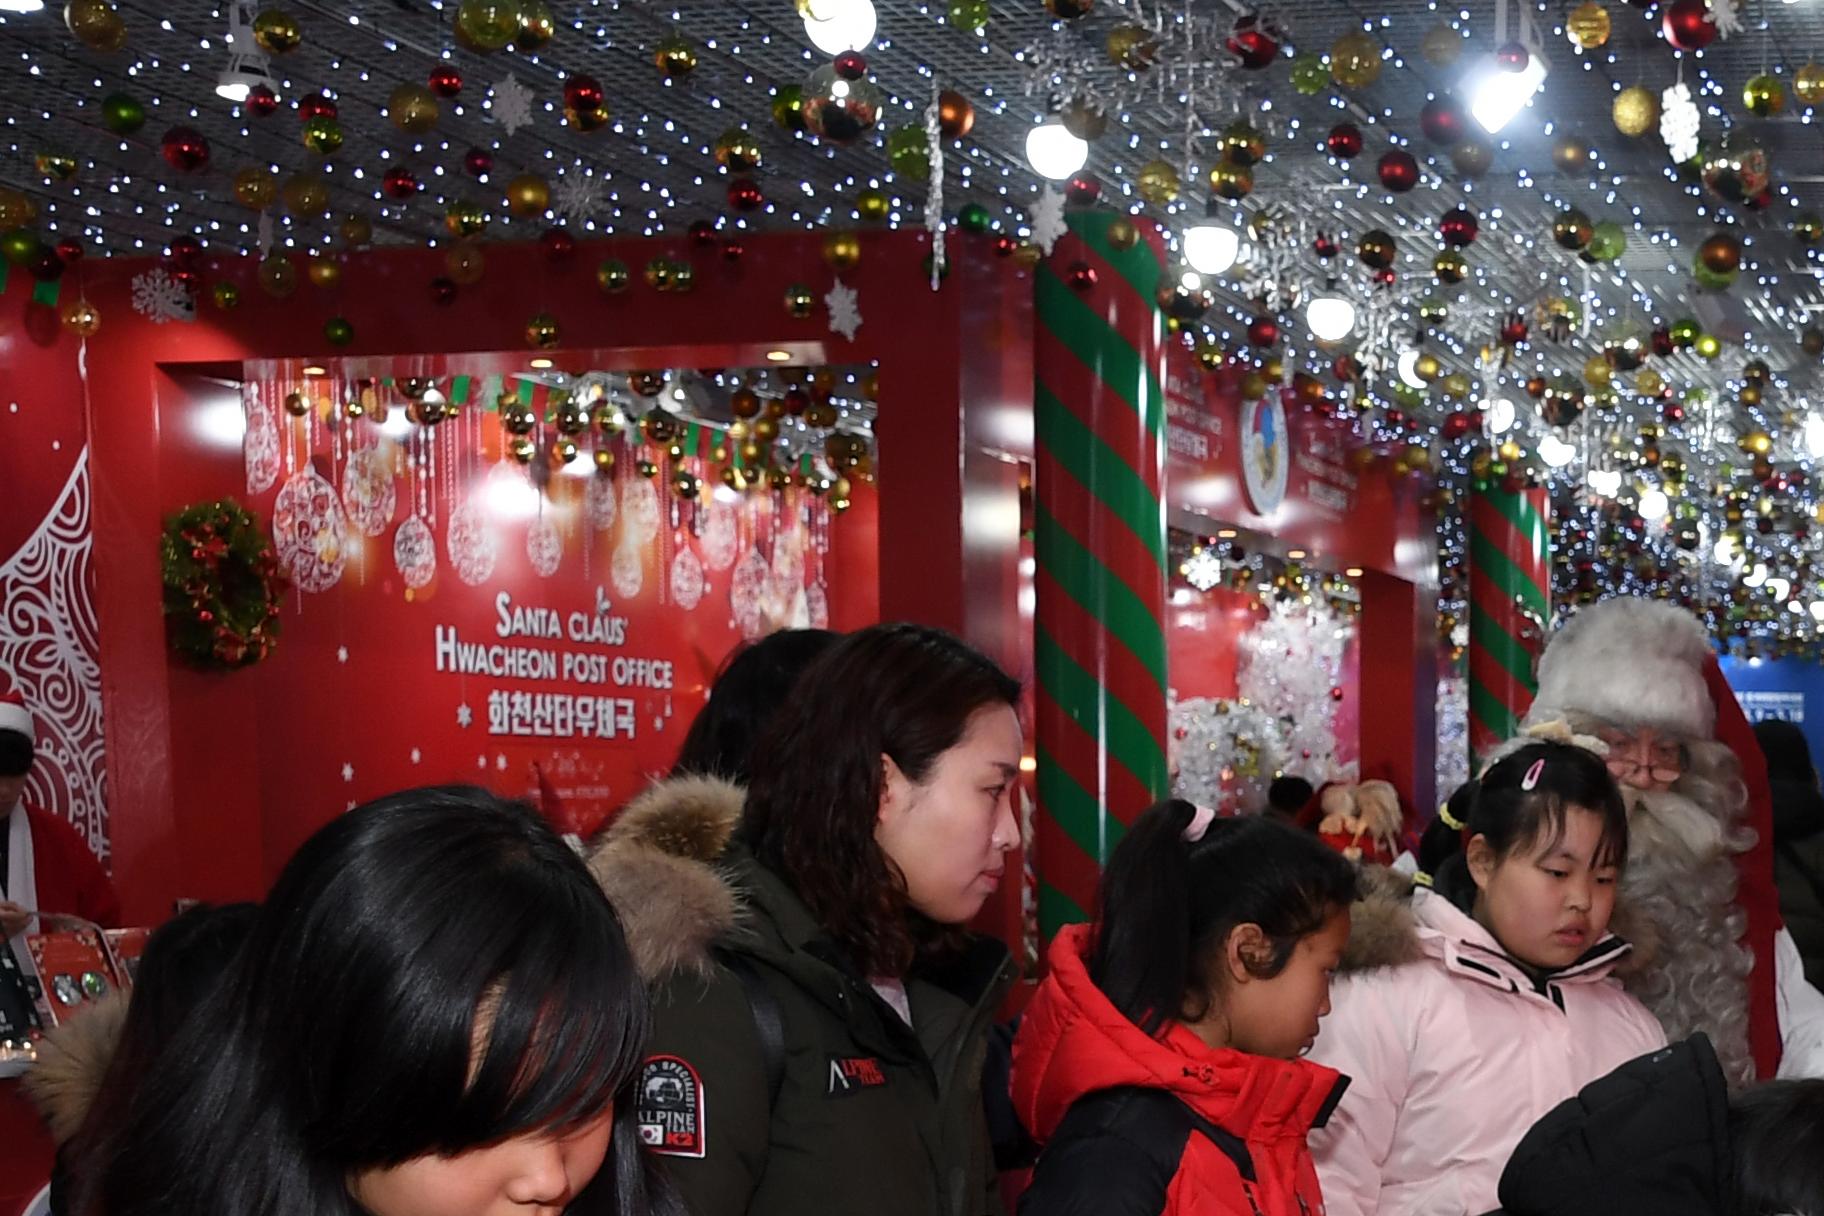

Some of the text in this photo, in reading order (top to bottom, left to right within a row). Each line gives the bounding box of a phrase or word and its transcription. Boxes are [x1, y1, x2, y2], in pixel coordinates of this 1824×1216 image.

[495, 591, 562, 638] SANTA
[435, 624, 674, 689] HWACHEON POST OFFICE
[488, 689, 636, 740] 화천산타우체국
